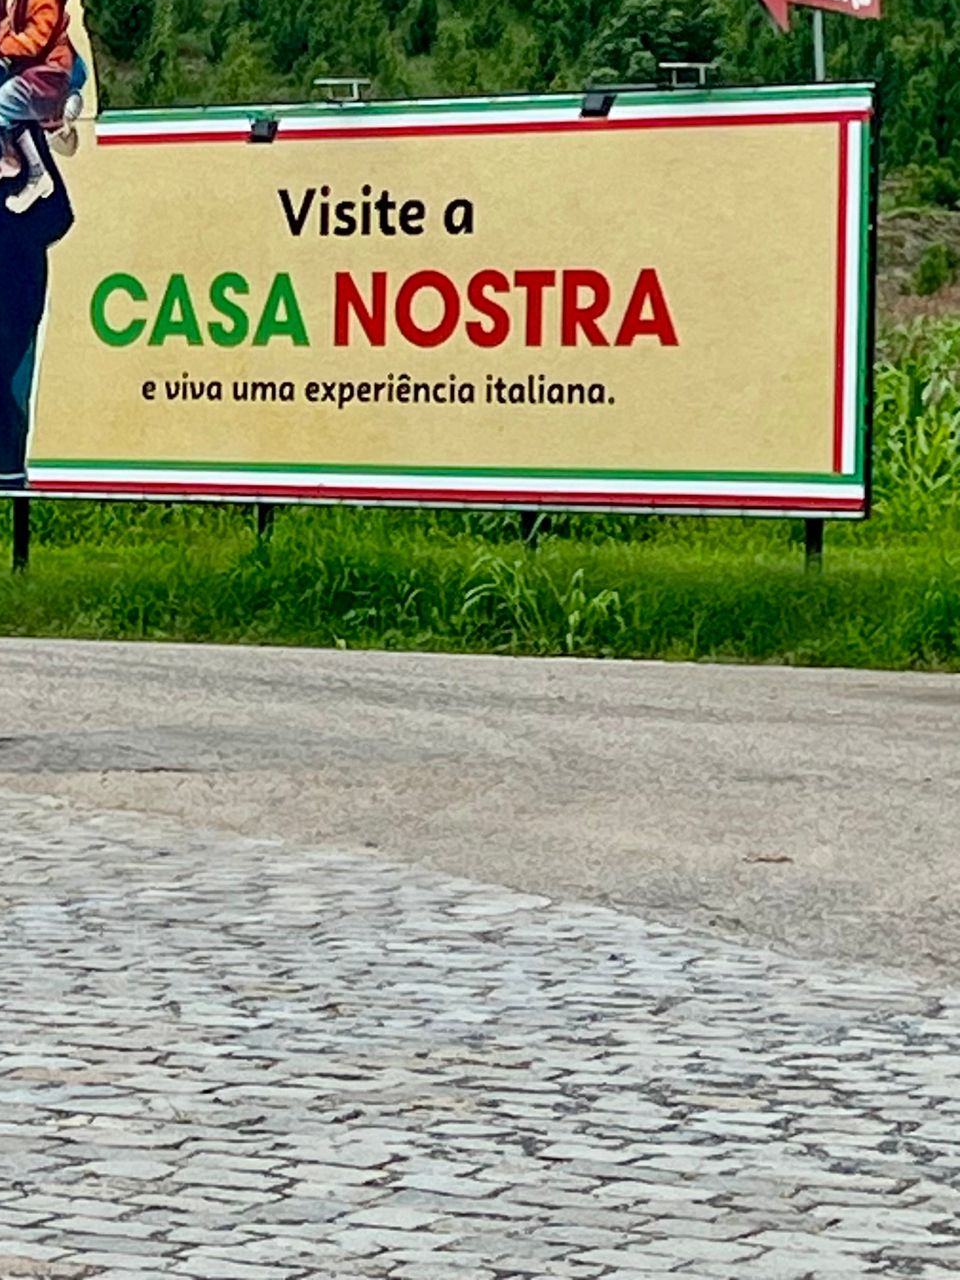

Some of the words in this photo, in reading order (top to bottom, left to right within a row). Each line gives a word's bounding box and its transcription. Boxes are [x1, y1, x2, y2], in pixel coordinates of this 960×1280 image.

[277, 184, 427, 237] Visite
[442, 197, 475, 236] a
[90, 271, 310, 347] CASA
[333, 267, 679, 348] NOSTRA
[141, 379, 158, 401] e
[164, 372, 224, 401] viva
[232, 380, 296, 402] uma
[303, 373, 476, 410] experiência
[485, 374, 616, 405] italiana.
